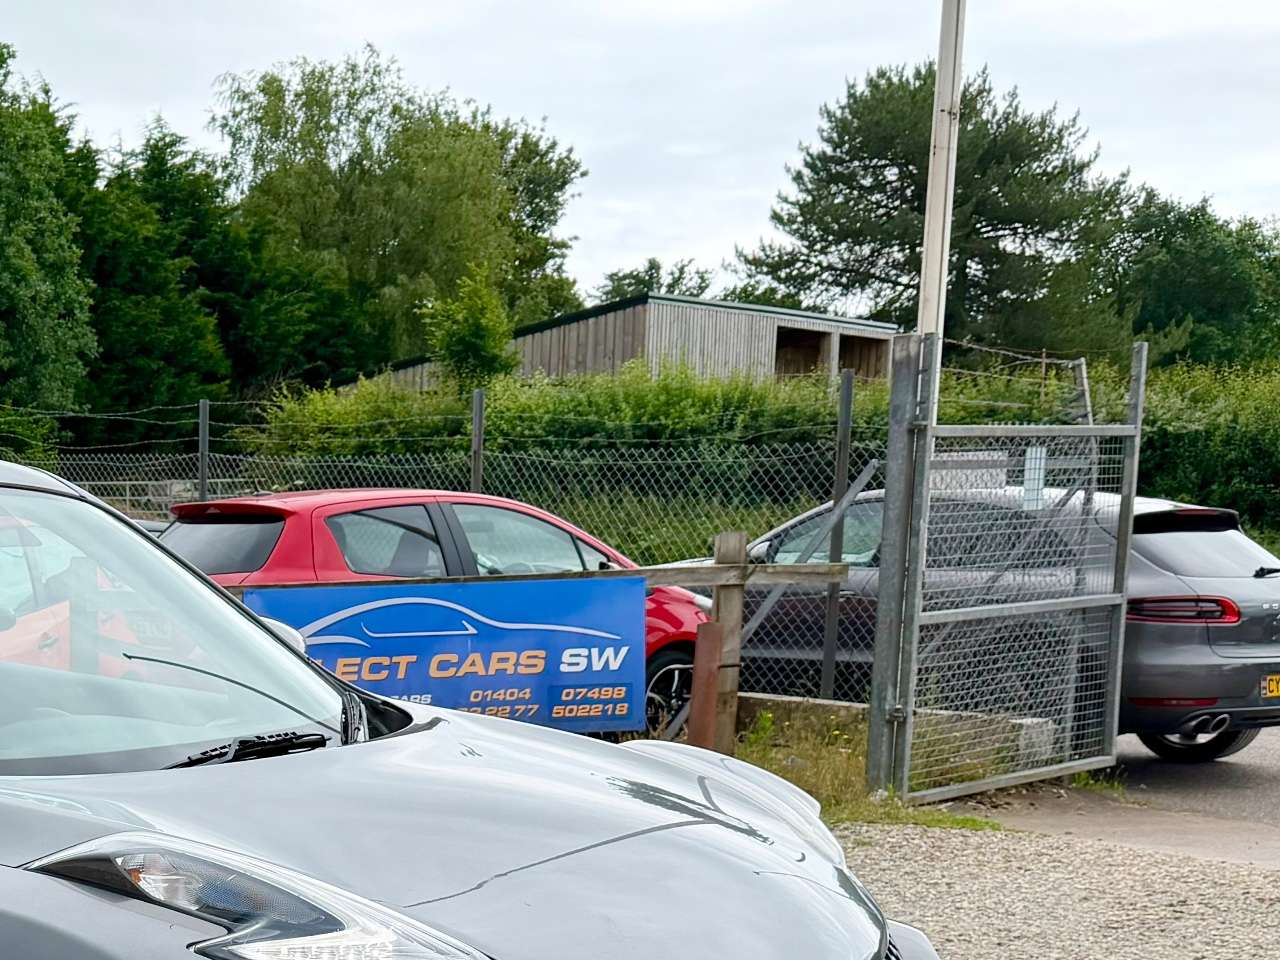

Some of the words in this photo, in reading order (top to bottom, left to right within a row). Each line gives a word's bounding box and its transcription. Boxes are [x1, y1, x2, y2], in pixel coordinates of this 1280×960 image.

[317, 655, 418, 682] ECT
[429, 650, 546, 678] CARS
[559, 646, 630, 673] SW
[392, 694, 433, 705] ARS
[470, 687, 532, 703] 01404
[561, 686, 626, 701] 07498
[551, 703, 629, 719] 502218
